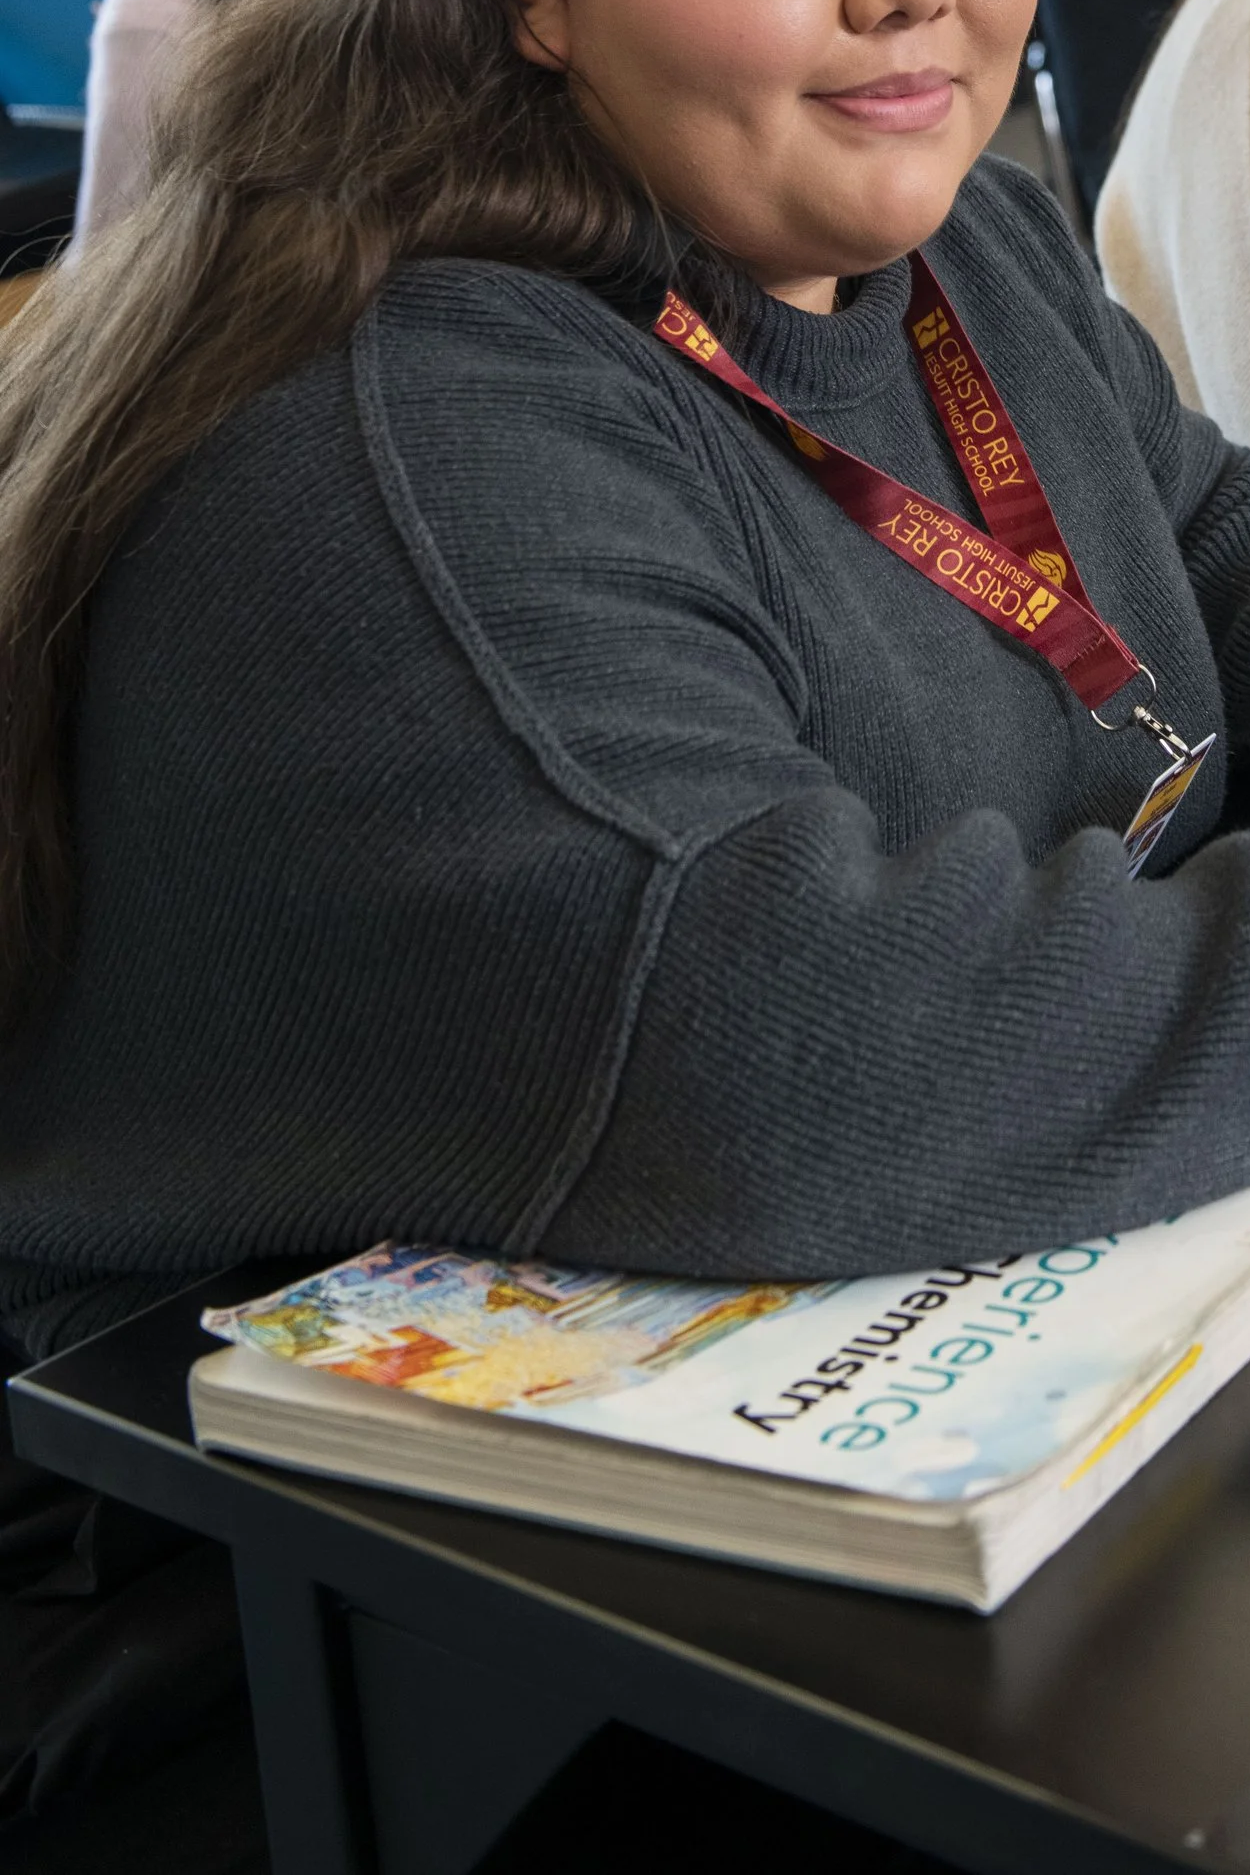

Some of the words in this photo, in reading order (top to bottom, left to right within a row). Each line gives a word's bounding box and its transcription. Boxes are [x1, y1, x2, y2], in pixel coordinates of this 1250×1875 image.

[924, 351, 952, 396] JESUIT
[944, 398, 969, 436] HIGH
[960, 436, 996, 498] SCHOOL
[938, 337, 997, 434] CRISTO
[983, 436, 1025, 486] REY
[878, 514, 939, 557] REY
[903, 498, 963, 542] SCHOOL
[960, 536, 998, 566] HIGH
[994, 559, 1037, 591] JESUIT
[936, 549, 1022, 616] CRISTO
[820, 1212, 1183, 1451] perience
